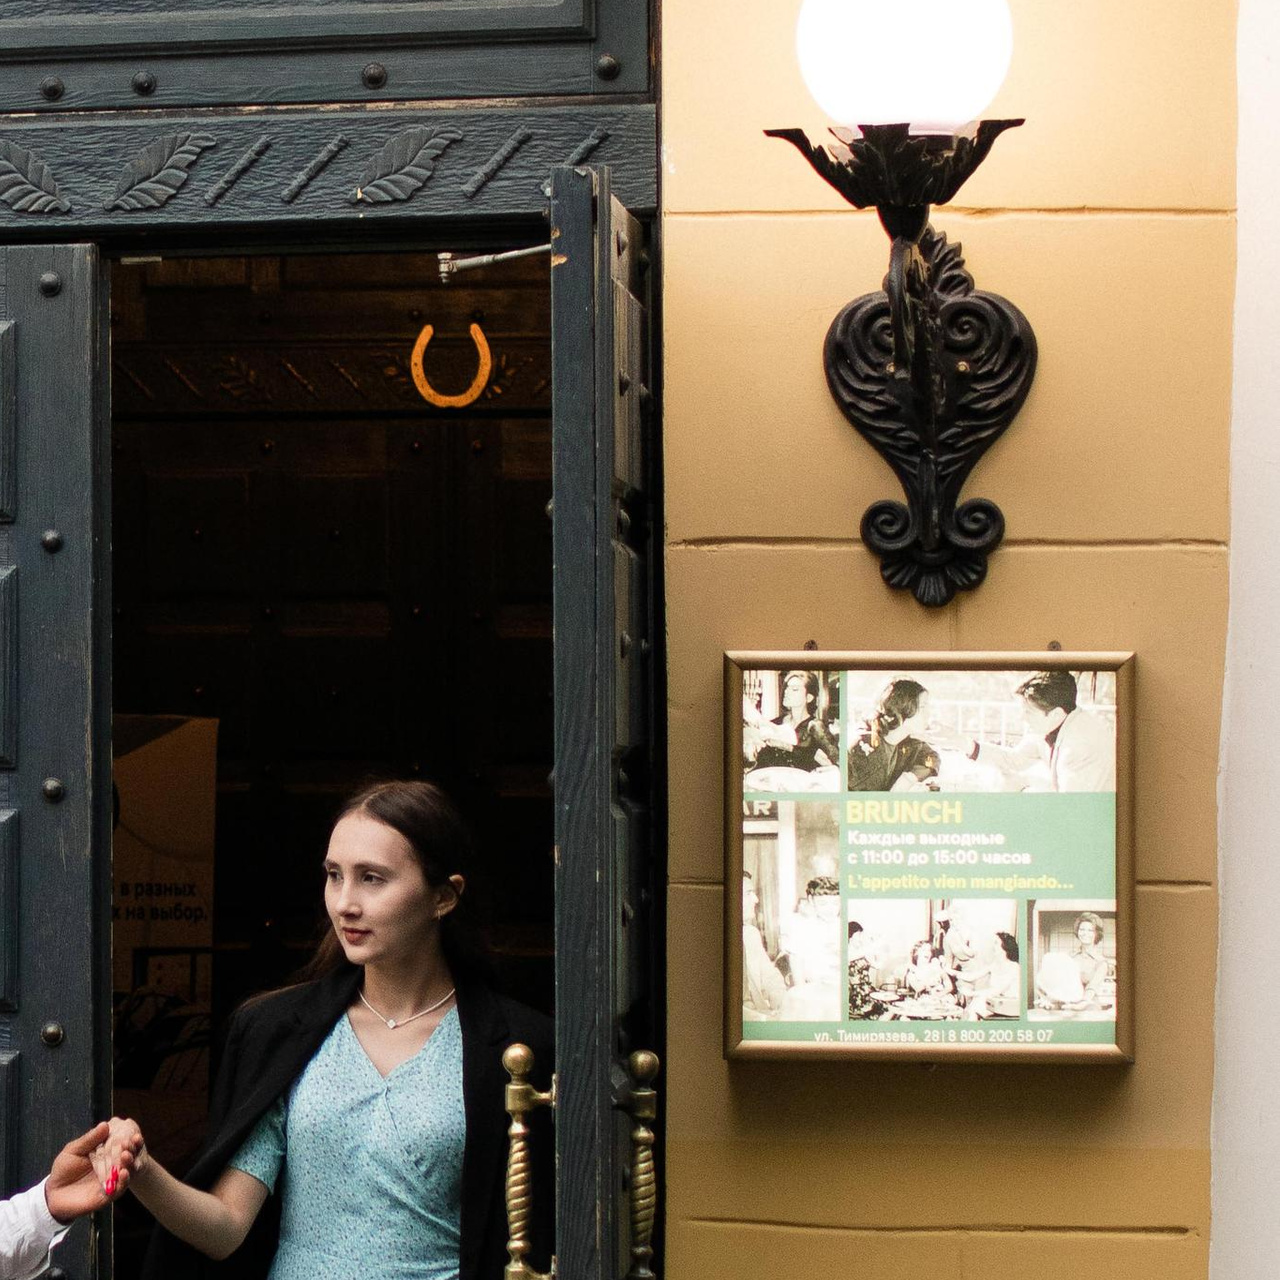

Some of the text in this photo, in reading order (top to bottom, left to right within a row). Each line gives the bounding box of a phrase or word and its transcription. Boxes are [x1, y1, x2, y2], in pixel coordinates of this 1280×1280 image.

[846, 800, 963, 824] BRUNCH
[848, 830, 1005, 847] Каждые выходные
[862, 850, 904, 865] 11:00
[907, 853, 929, 867] до
[933, 850, 977, 865] 15:00
[982, 852, 1032, 865] часов
[134, 882, 196, 899] разных
[848, 874, 930, 891] L'appetito
[933, 874, 966, 889] vien
[960, 1029, 985, 1043] 800
[989, 1029, 1013, 1043] 200
[1017, 1029, 1033, 1043] 58
[1037, 1029, 1054, 1042] 07
